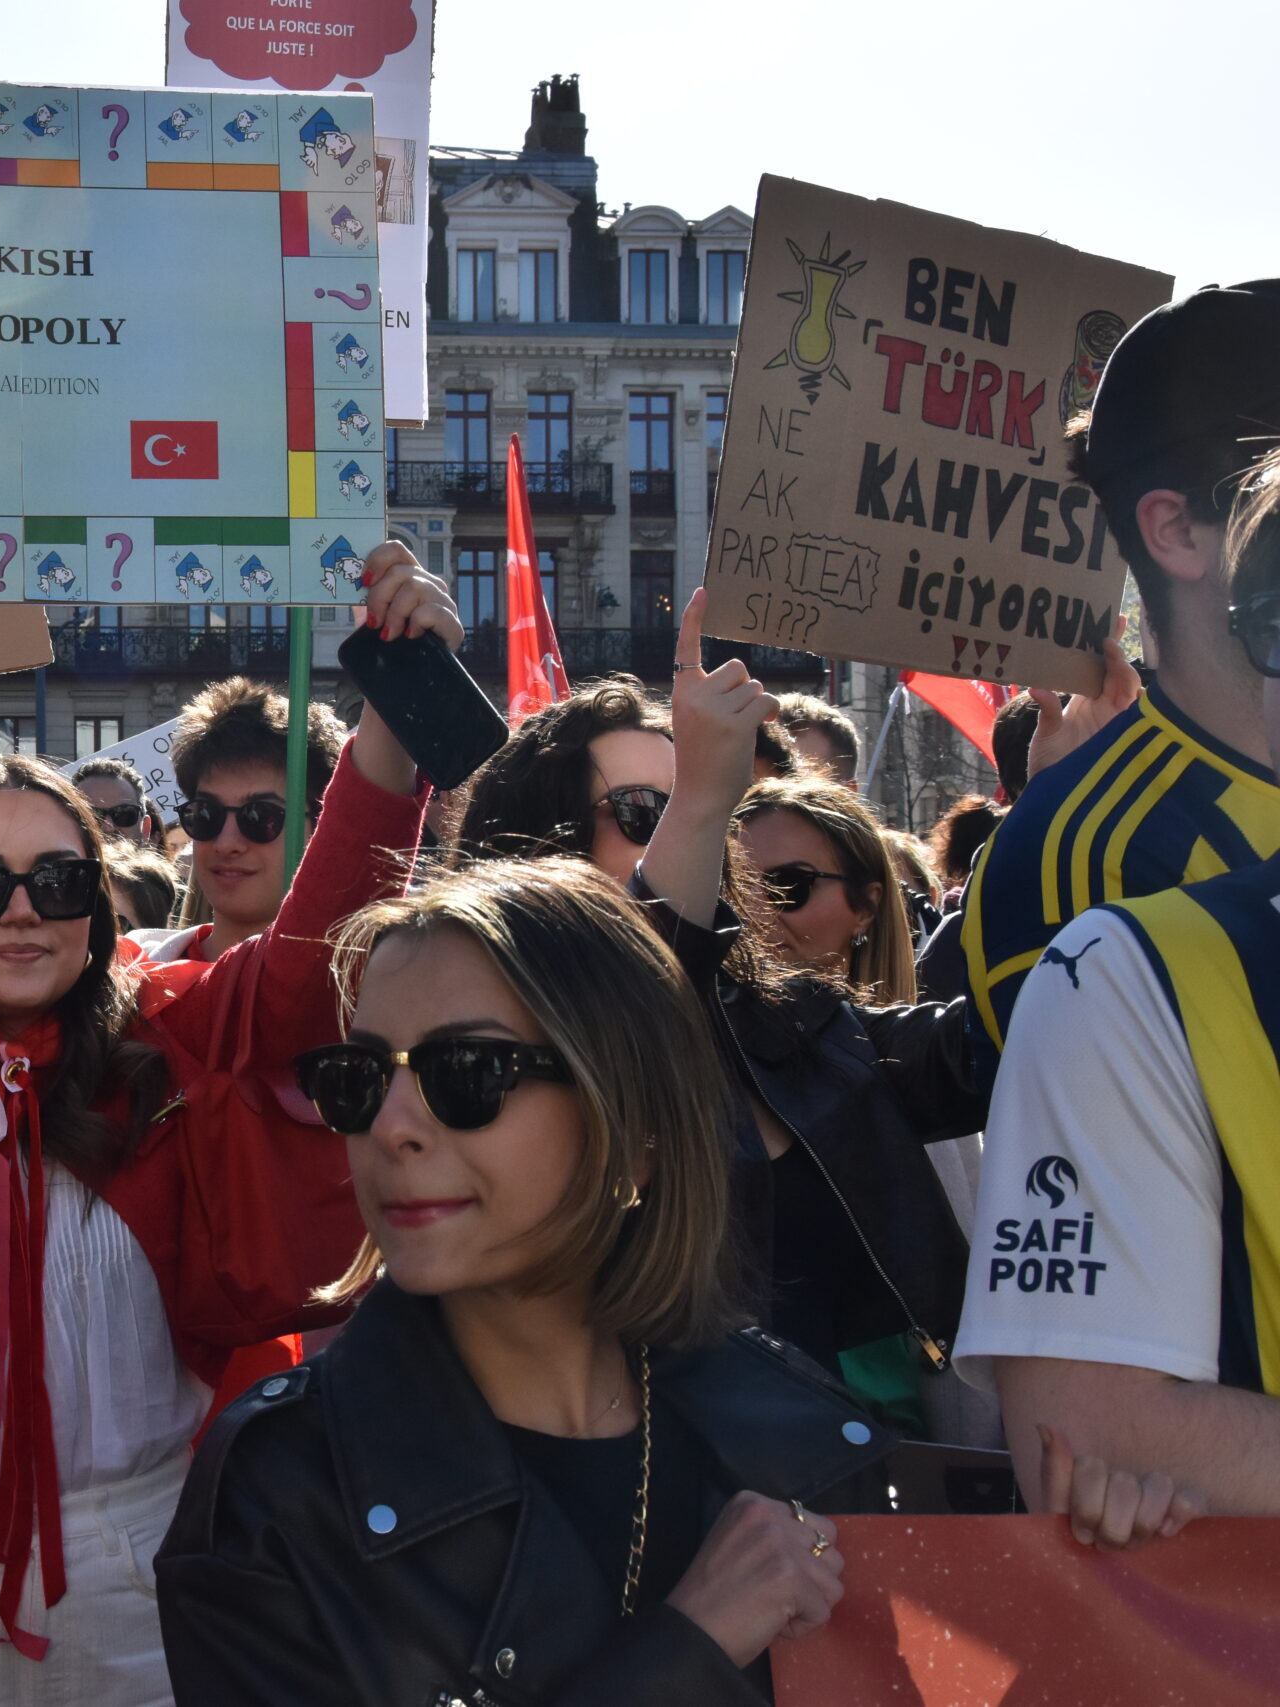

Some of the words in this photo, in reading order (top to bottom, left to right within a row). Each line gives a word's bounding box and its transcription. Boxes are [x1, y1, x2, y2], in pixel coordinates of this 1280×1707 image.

[226, 16, 255, 31] QUE
[259, 19, 275, 31] LA
[279, 20, 321, 35] FORCE
[324, 23, 355, 37] SOIT
[266, 42, 306, 56] JUSTE
[288, 105, 308, 124] JAIL
[344, 172, 359, 186] TO
[356, 159, 371, 175] GO
[905, 257, 1017, 347] BEN
[384, 310, 410, 329] EN
[758, 404, 811, 456] NE
[741, 469, 799, 522] AK
[311, 533, 328, 551] JAIL
[952, 634, 1012, 678] !!!
[970, 679, 994, 706] ARTI
[992, 1211, 1095, 1256] SAFİ
[988, 1258, 1107, 1297] PORT
